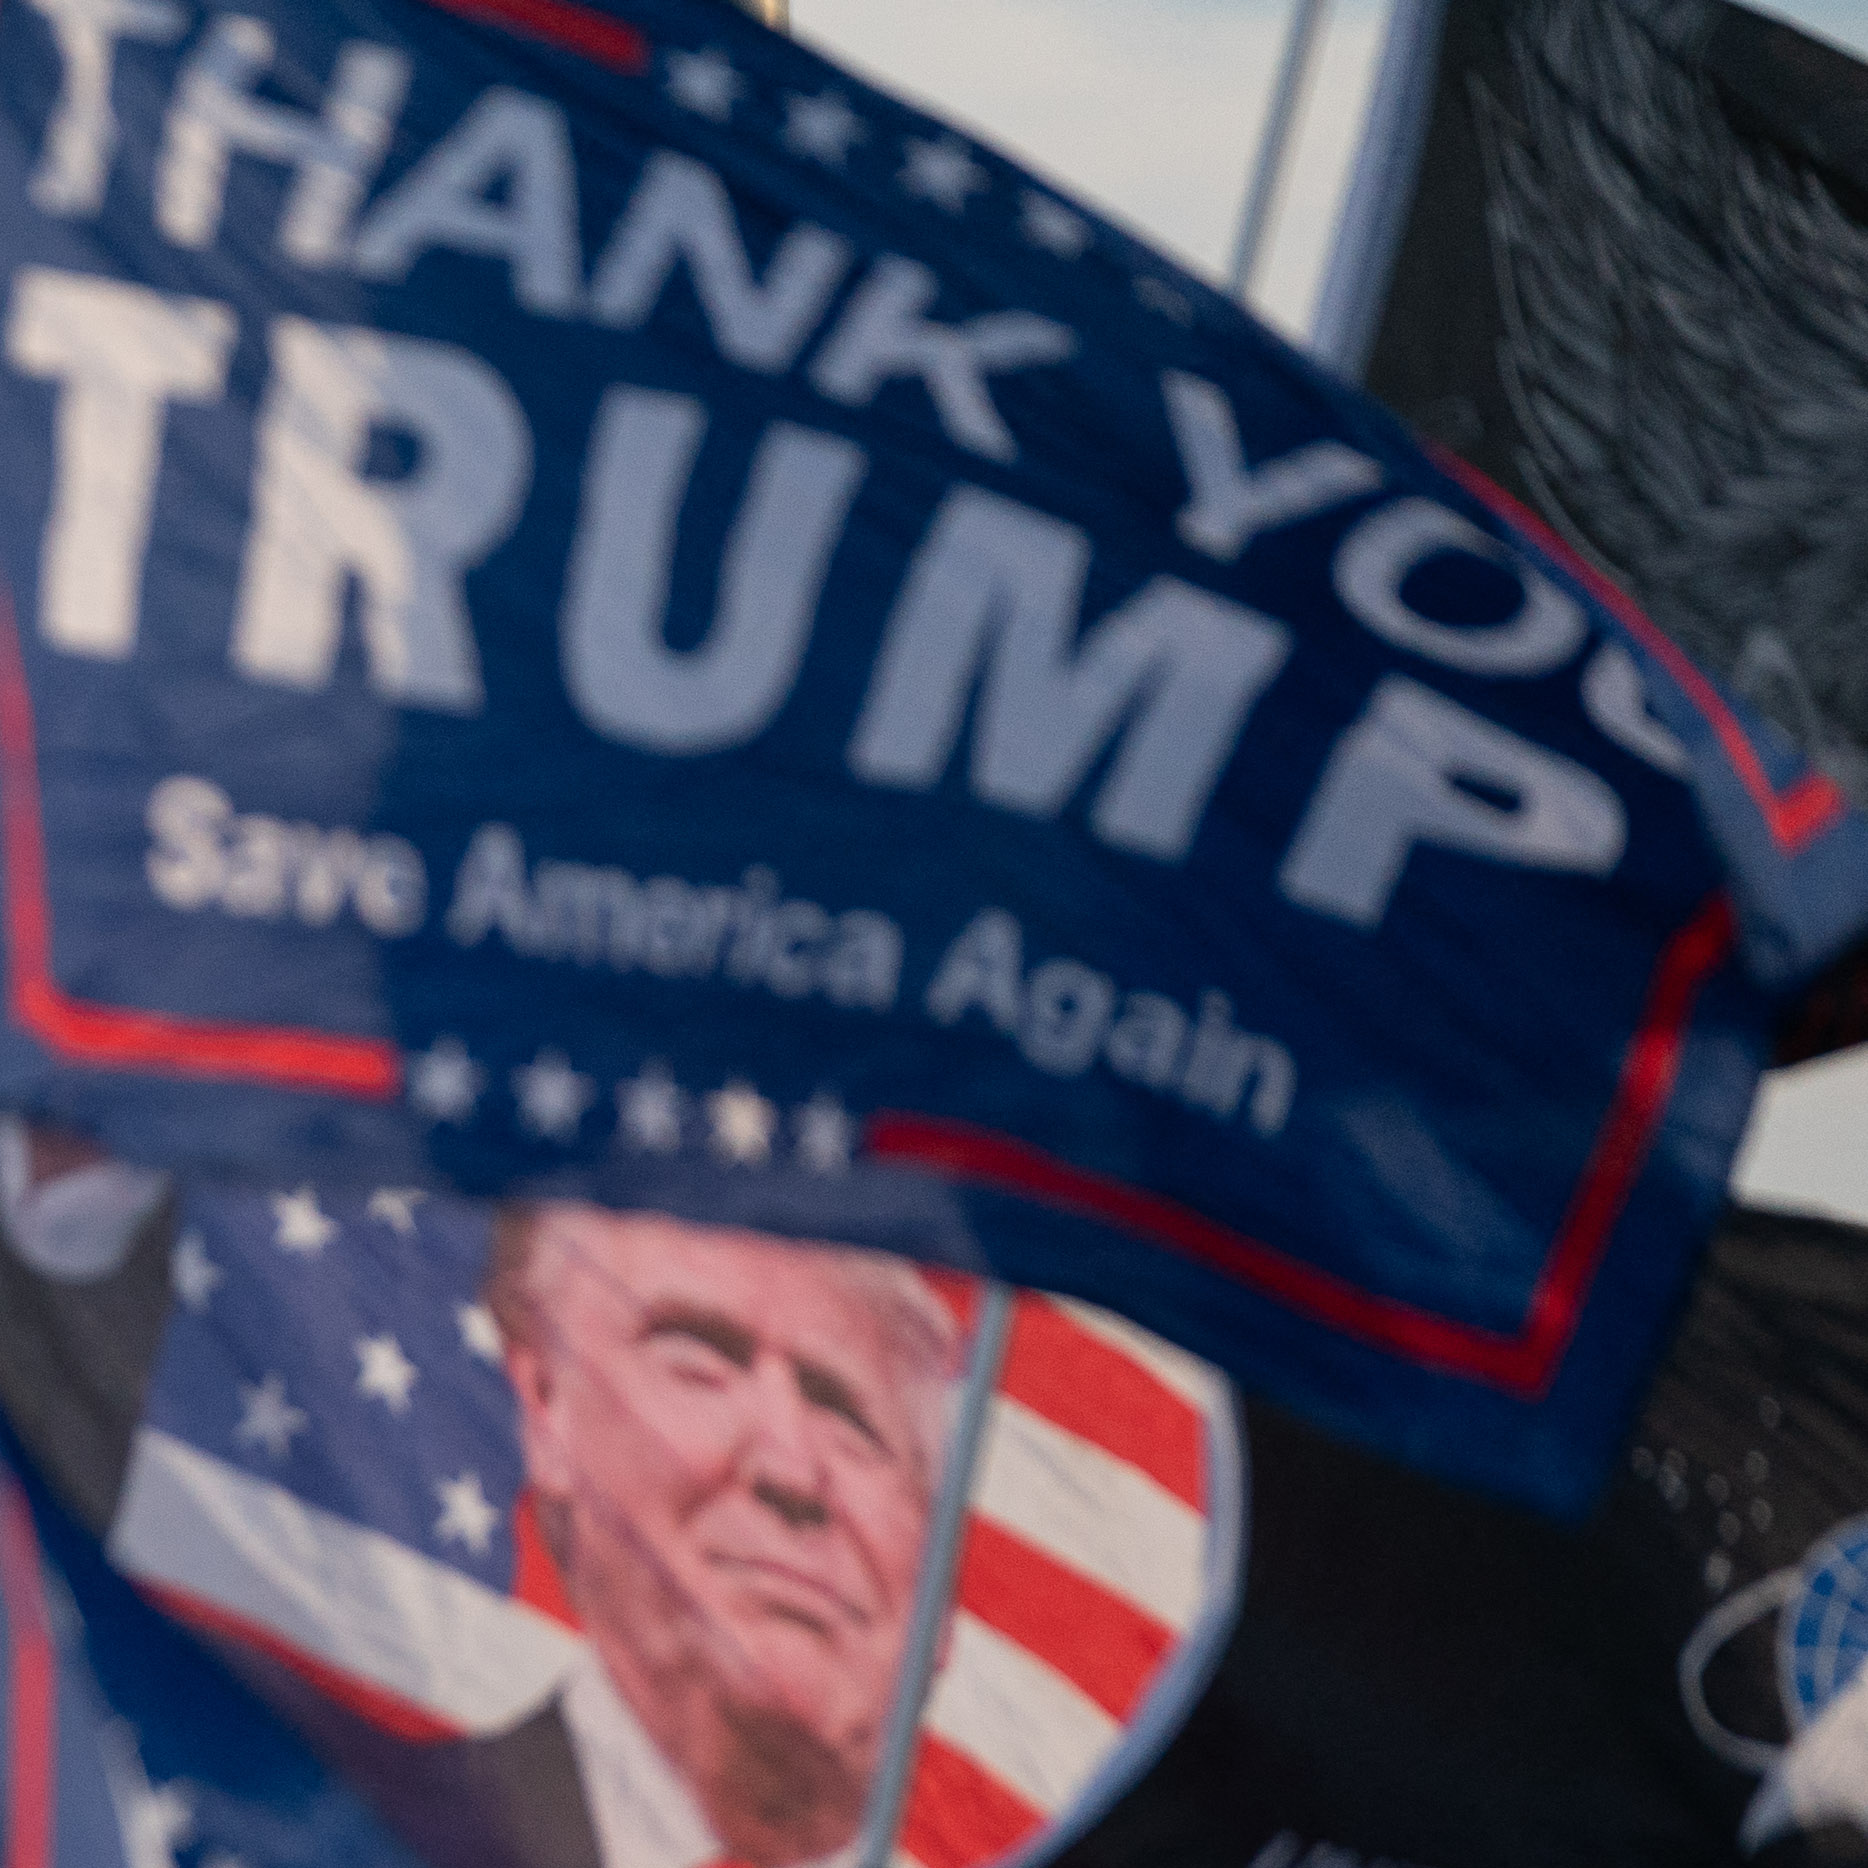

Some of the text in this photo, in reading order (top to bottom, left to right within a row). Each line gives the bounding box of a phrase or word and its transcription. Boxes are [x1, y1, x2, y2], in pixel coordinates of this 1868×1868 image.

[28, 0, 1076, 458] THANK
[5, 268, 1628, 928] TRUMP
[146, 772, 1298, 1132] Save America Again
